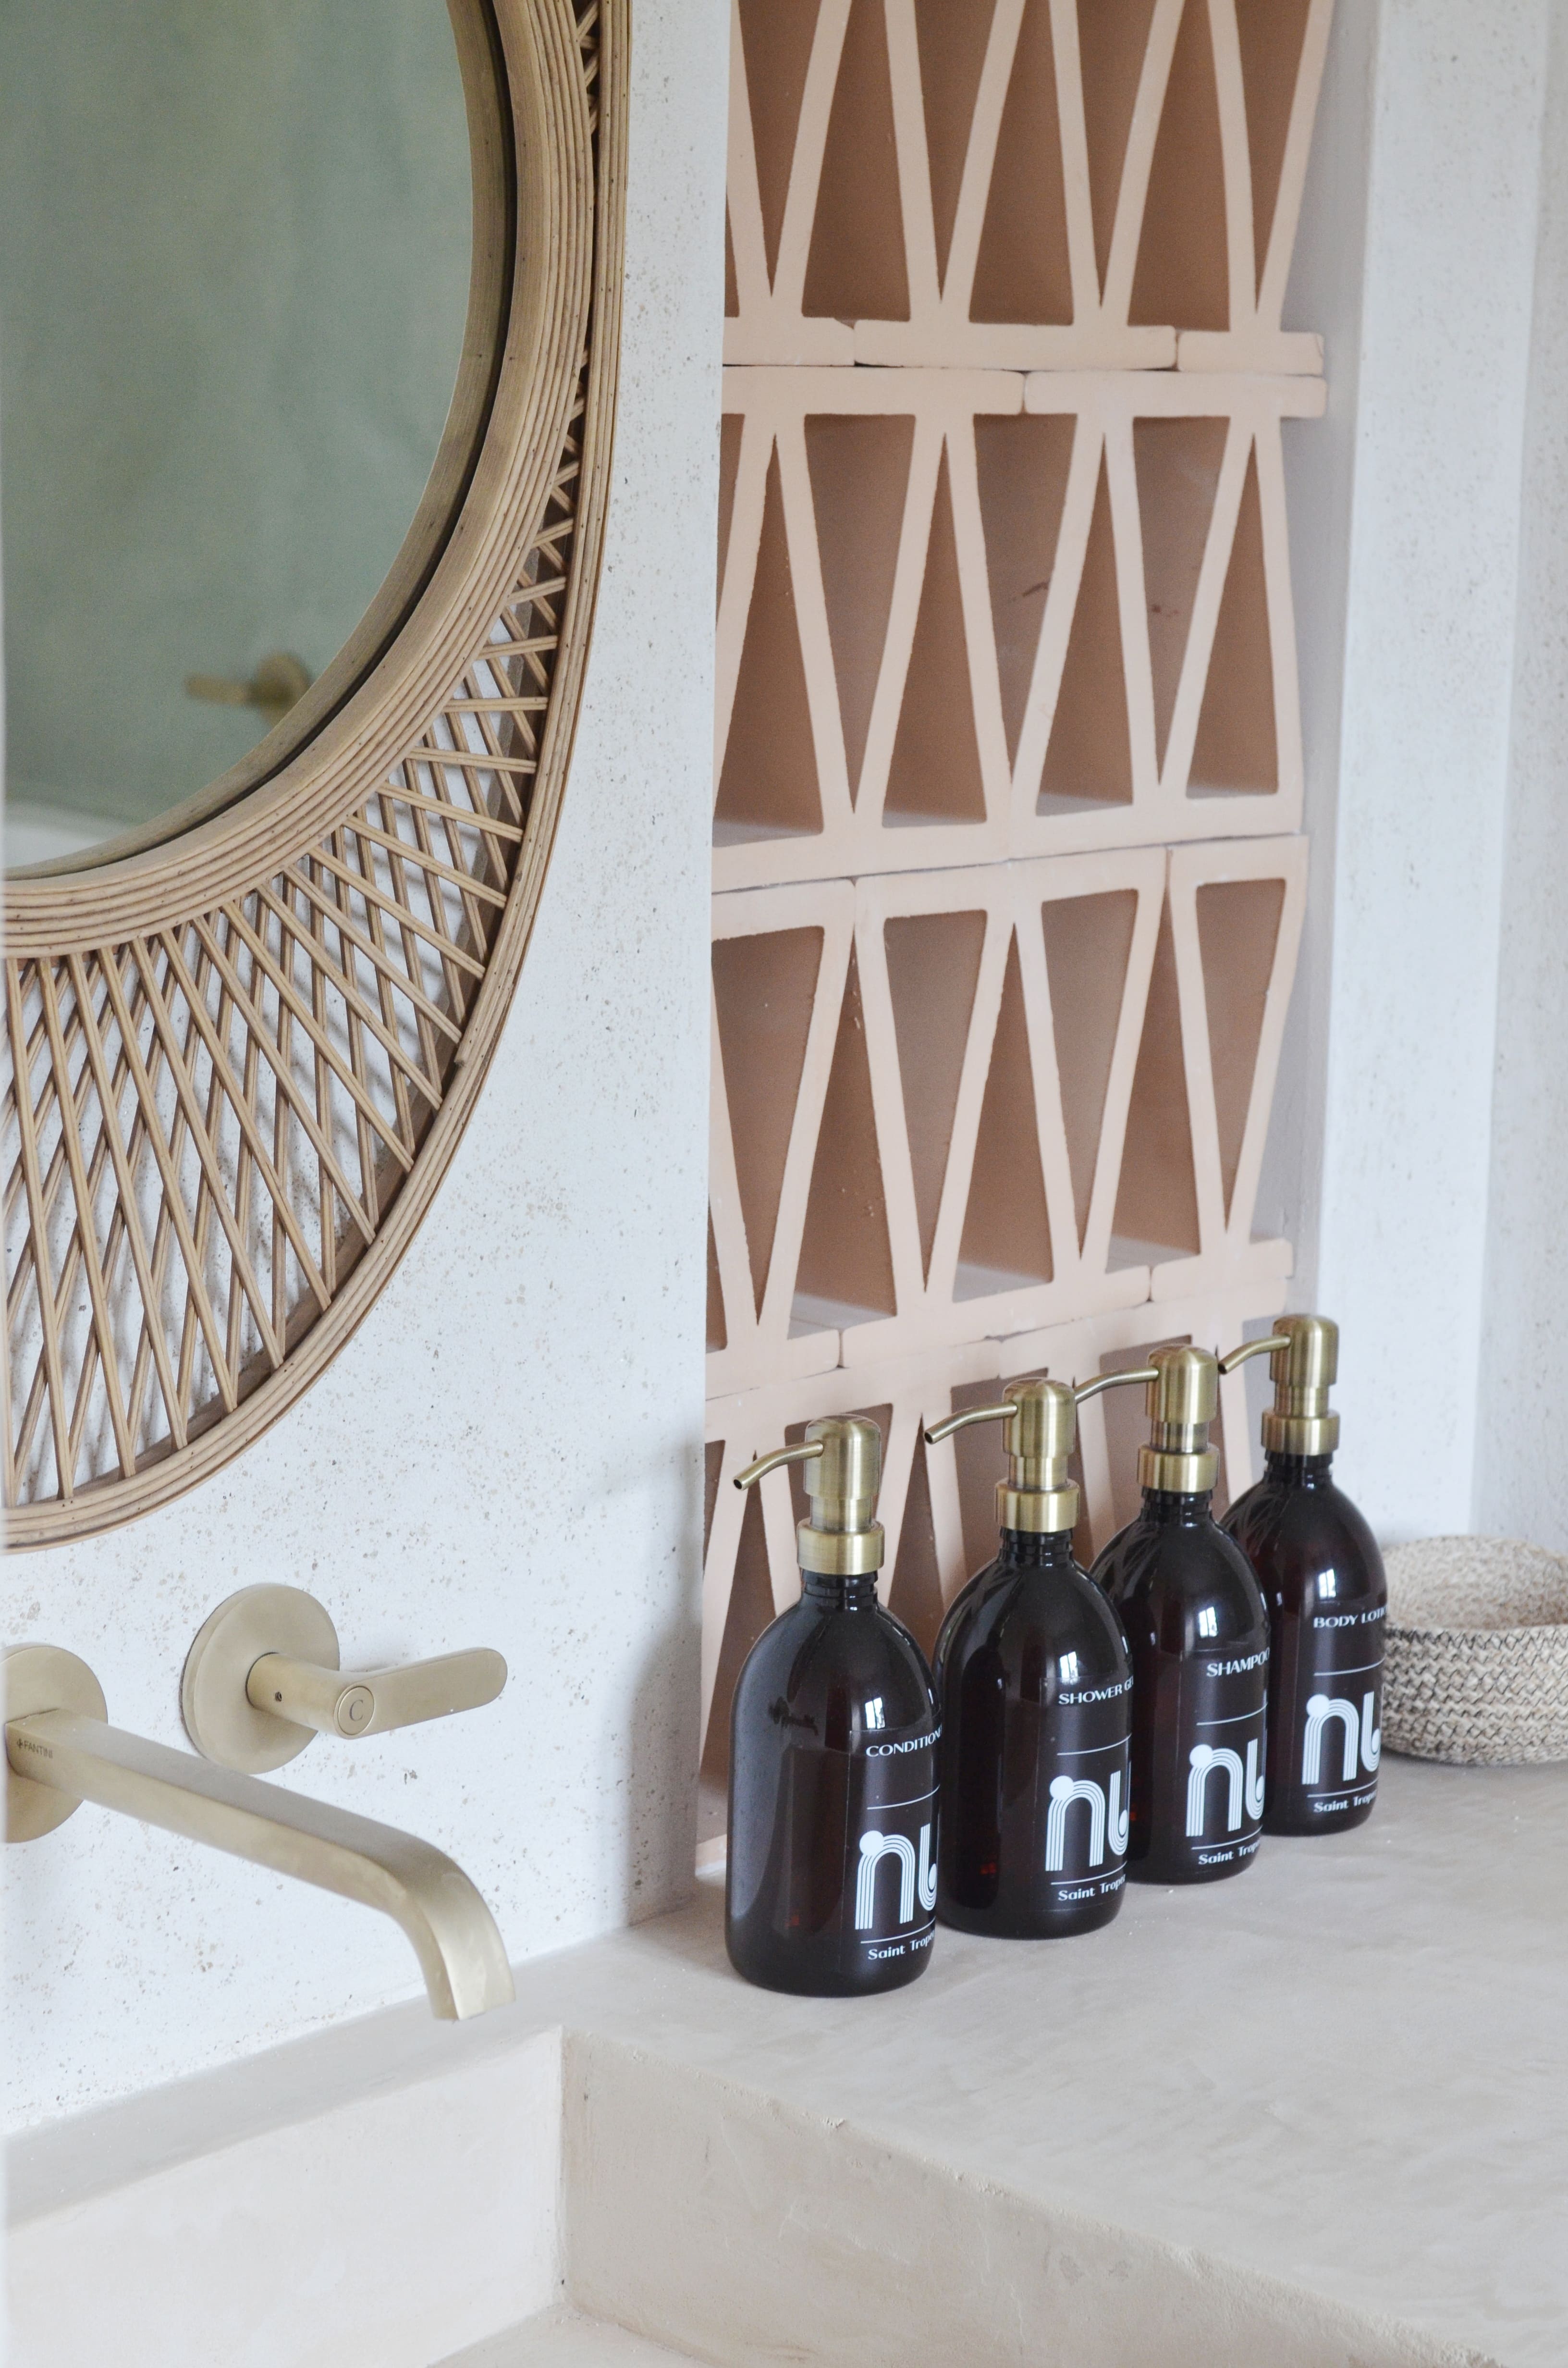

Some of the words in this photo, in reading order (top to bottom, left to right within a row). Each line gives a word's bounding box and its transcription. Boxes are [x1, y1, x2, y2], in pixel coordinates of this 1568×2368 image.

[1313, 1615, 1359, 1628] BODY
[1206, 1646, 1270, 1677] SHAMPOO
[1058, 1684, 1123, 1705] SHOWER
[349, 1699, 364, 1721] C
[24, 1740, 53, 1759] FANTINI
[1313, 1800, 1349, 1813] Saint
[1198, 1850, 1234, 1865] Saint
[1058, 1887, 1095, 1901] Saint
[868, 1945, 906, 1960] Saint
